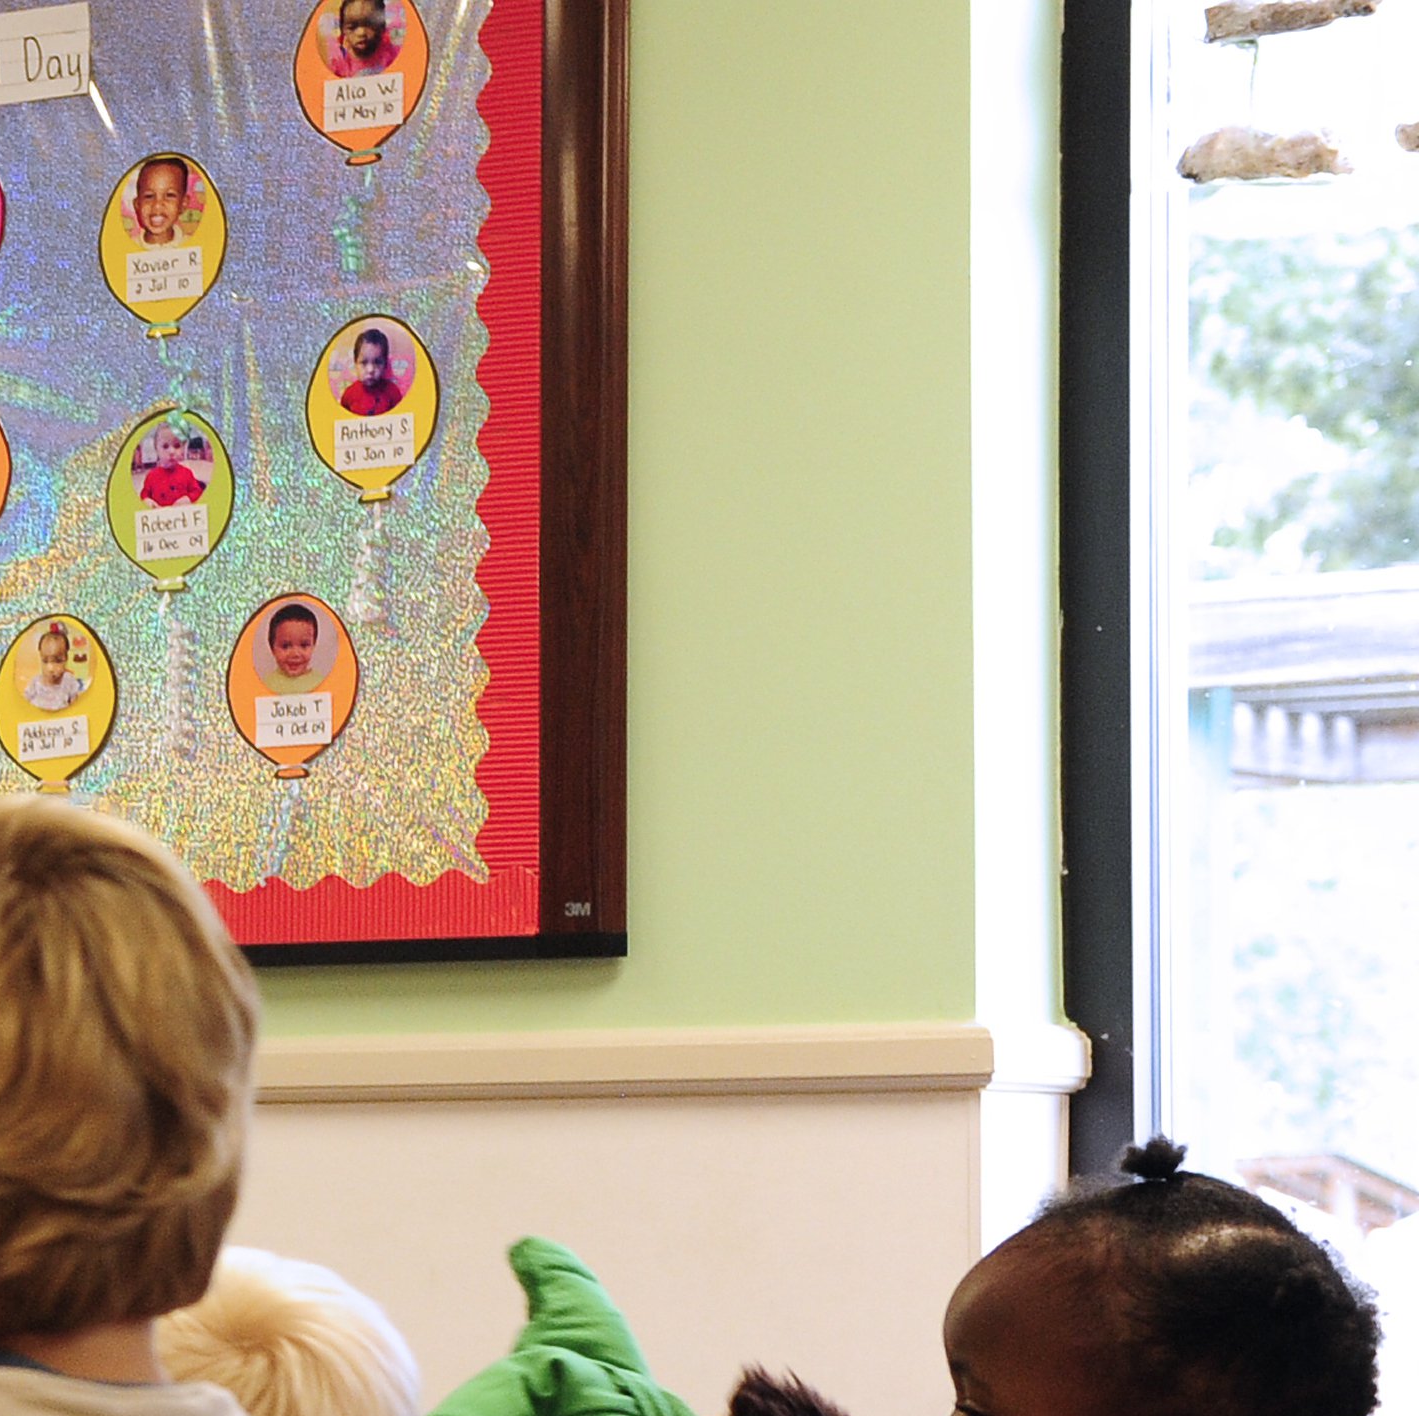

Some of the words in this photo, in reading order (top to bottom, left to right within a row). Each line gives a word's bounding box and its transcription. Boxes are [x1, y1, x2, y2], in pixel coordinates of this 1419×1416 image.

[22, 35, 83, 93] Day
[352, 105, 377, 121] May
[132, 258, 180, 276] Xavier
[148, 277, 168, 293] Jul
[177, 277, 190, 291] 10
[341, 422, 393, 442] Anthony
[141, 511, 188, 534] Robert
[564, 901, 591, 917] 3M
